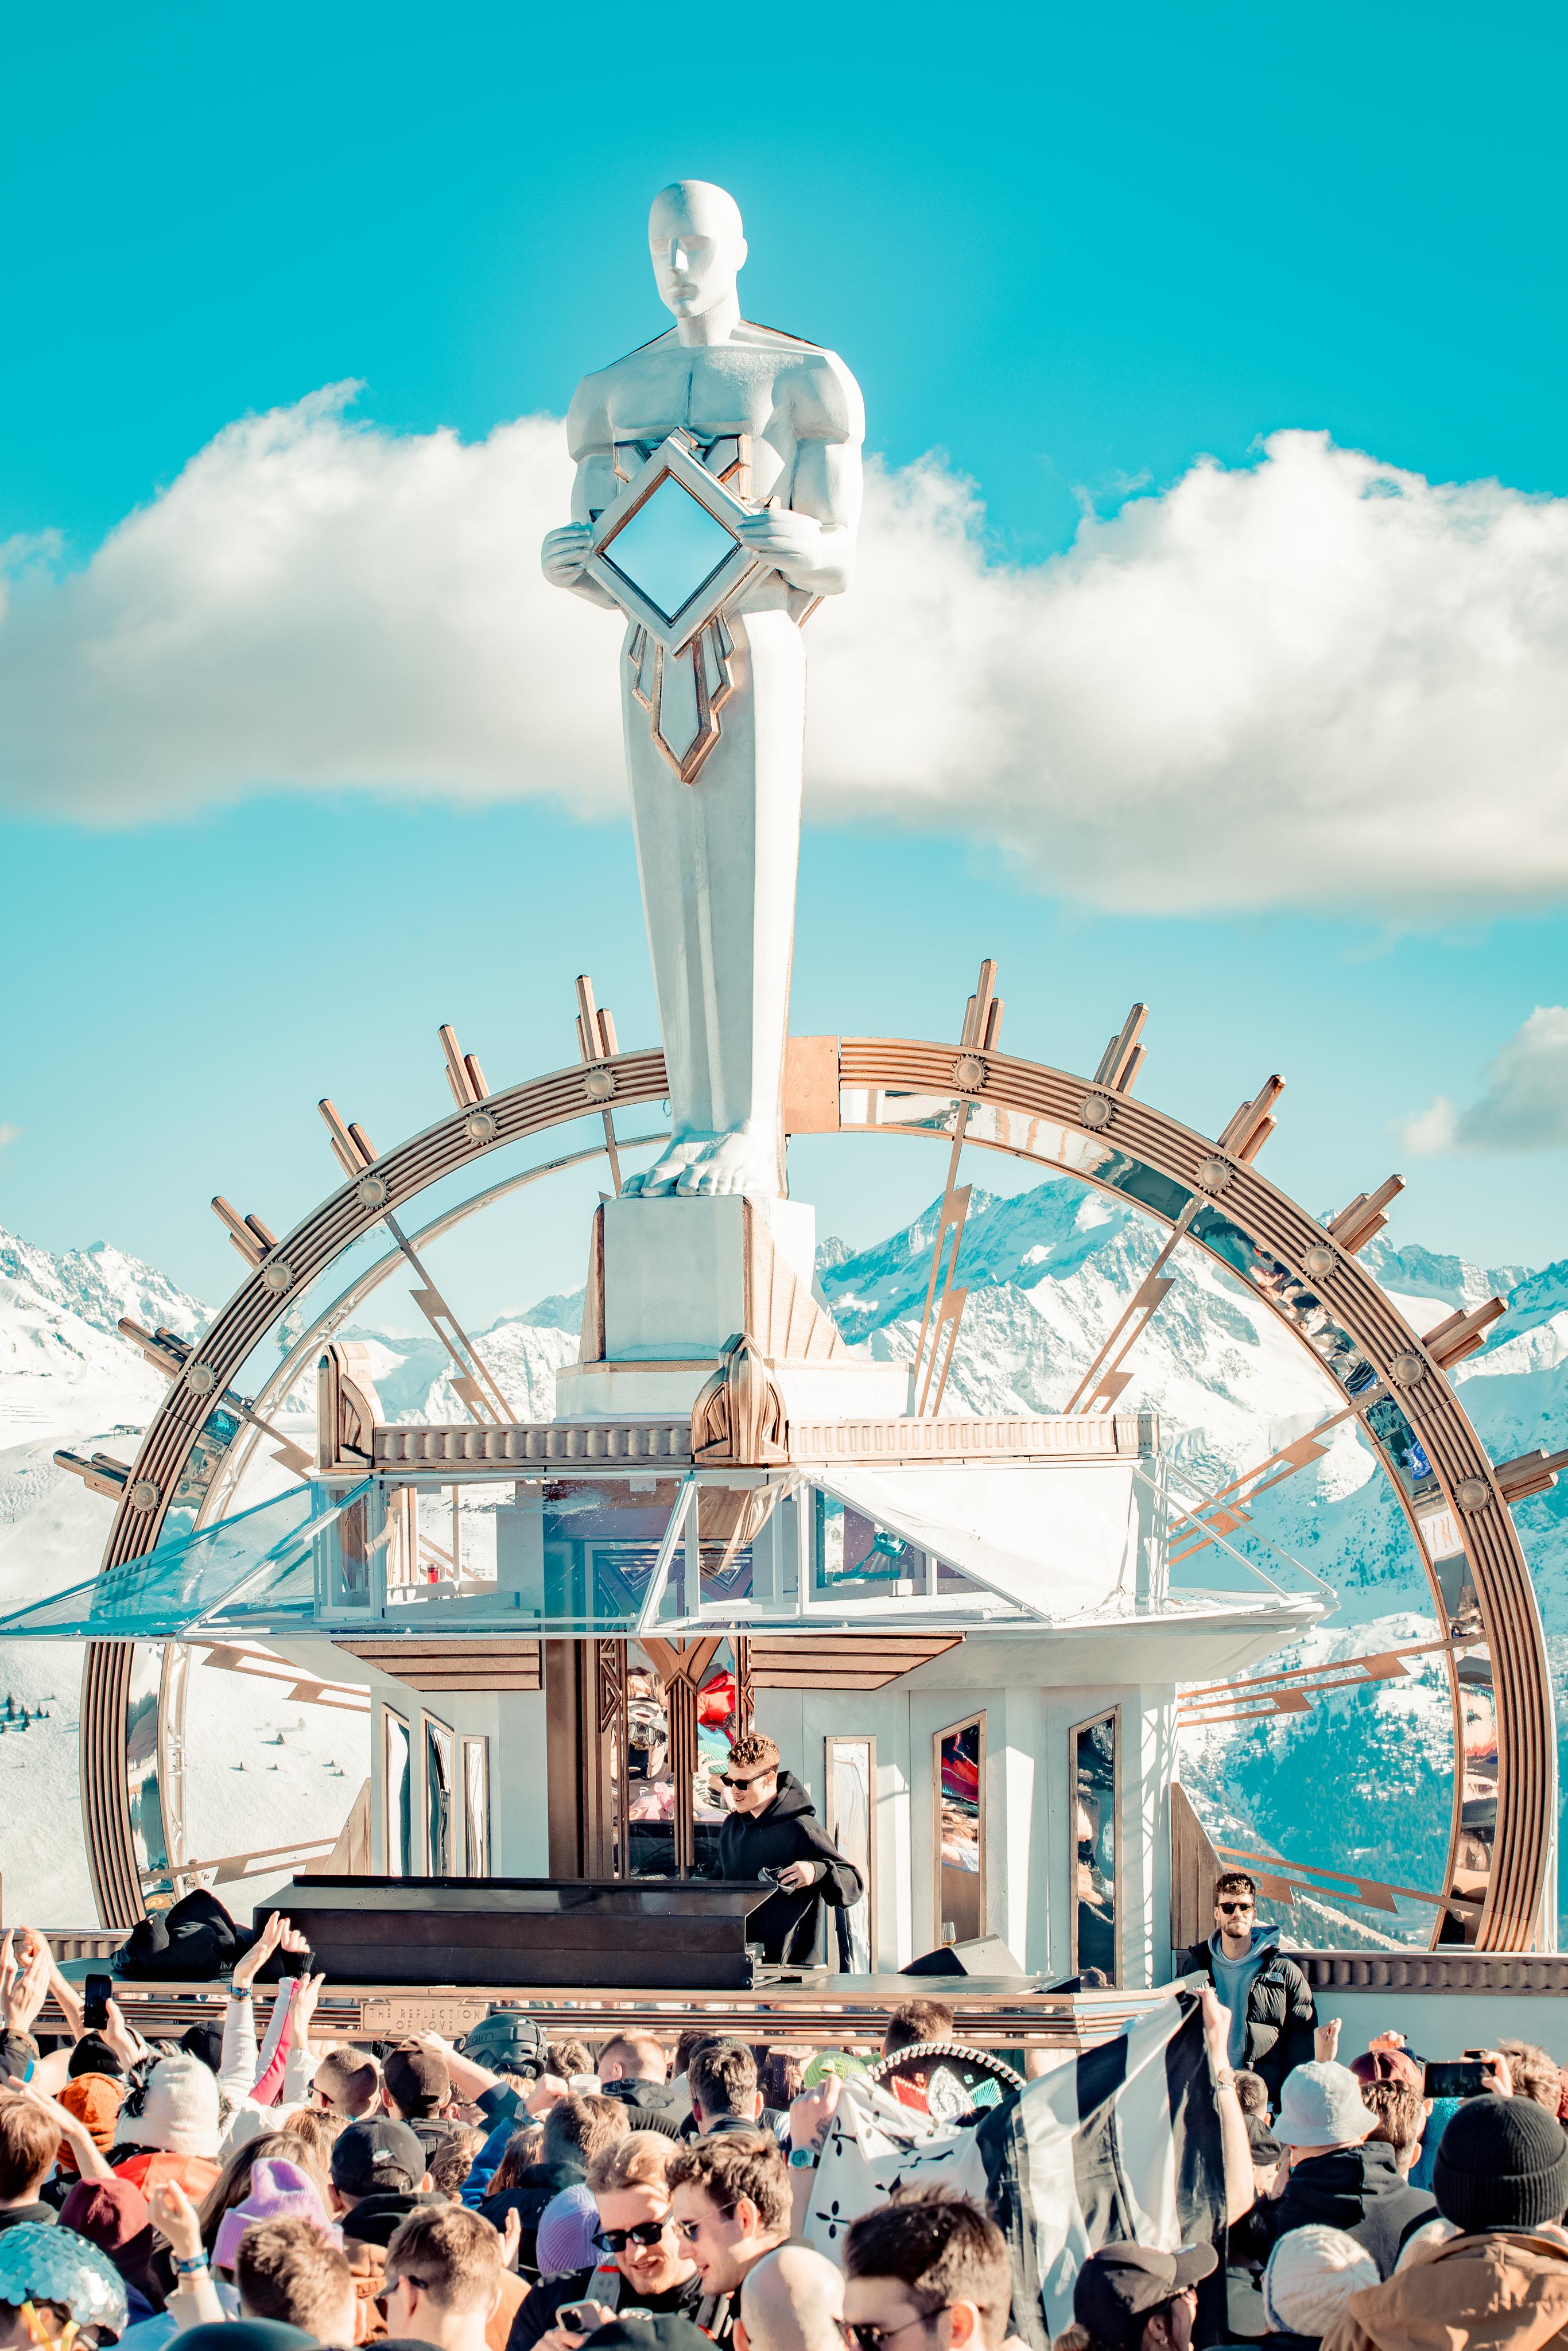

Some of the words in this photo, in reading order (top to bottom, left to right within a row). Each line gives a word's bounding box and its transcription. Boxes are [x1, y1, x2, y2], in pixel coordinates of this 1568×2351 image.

[369, 2008, 391, 2018] THE
[401, 2009, 480, 2019] REFLECTION
[396, 2020, 412, 2030] OF
[421, 2021, 453, 2031] LOVE
[466, 2032, 494, 2046] cairn
